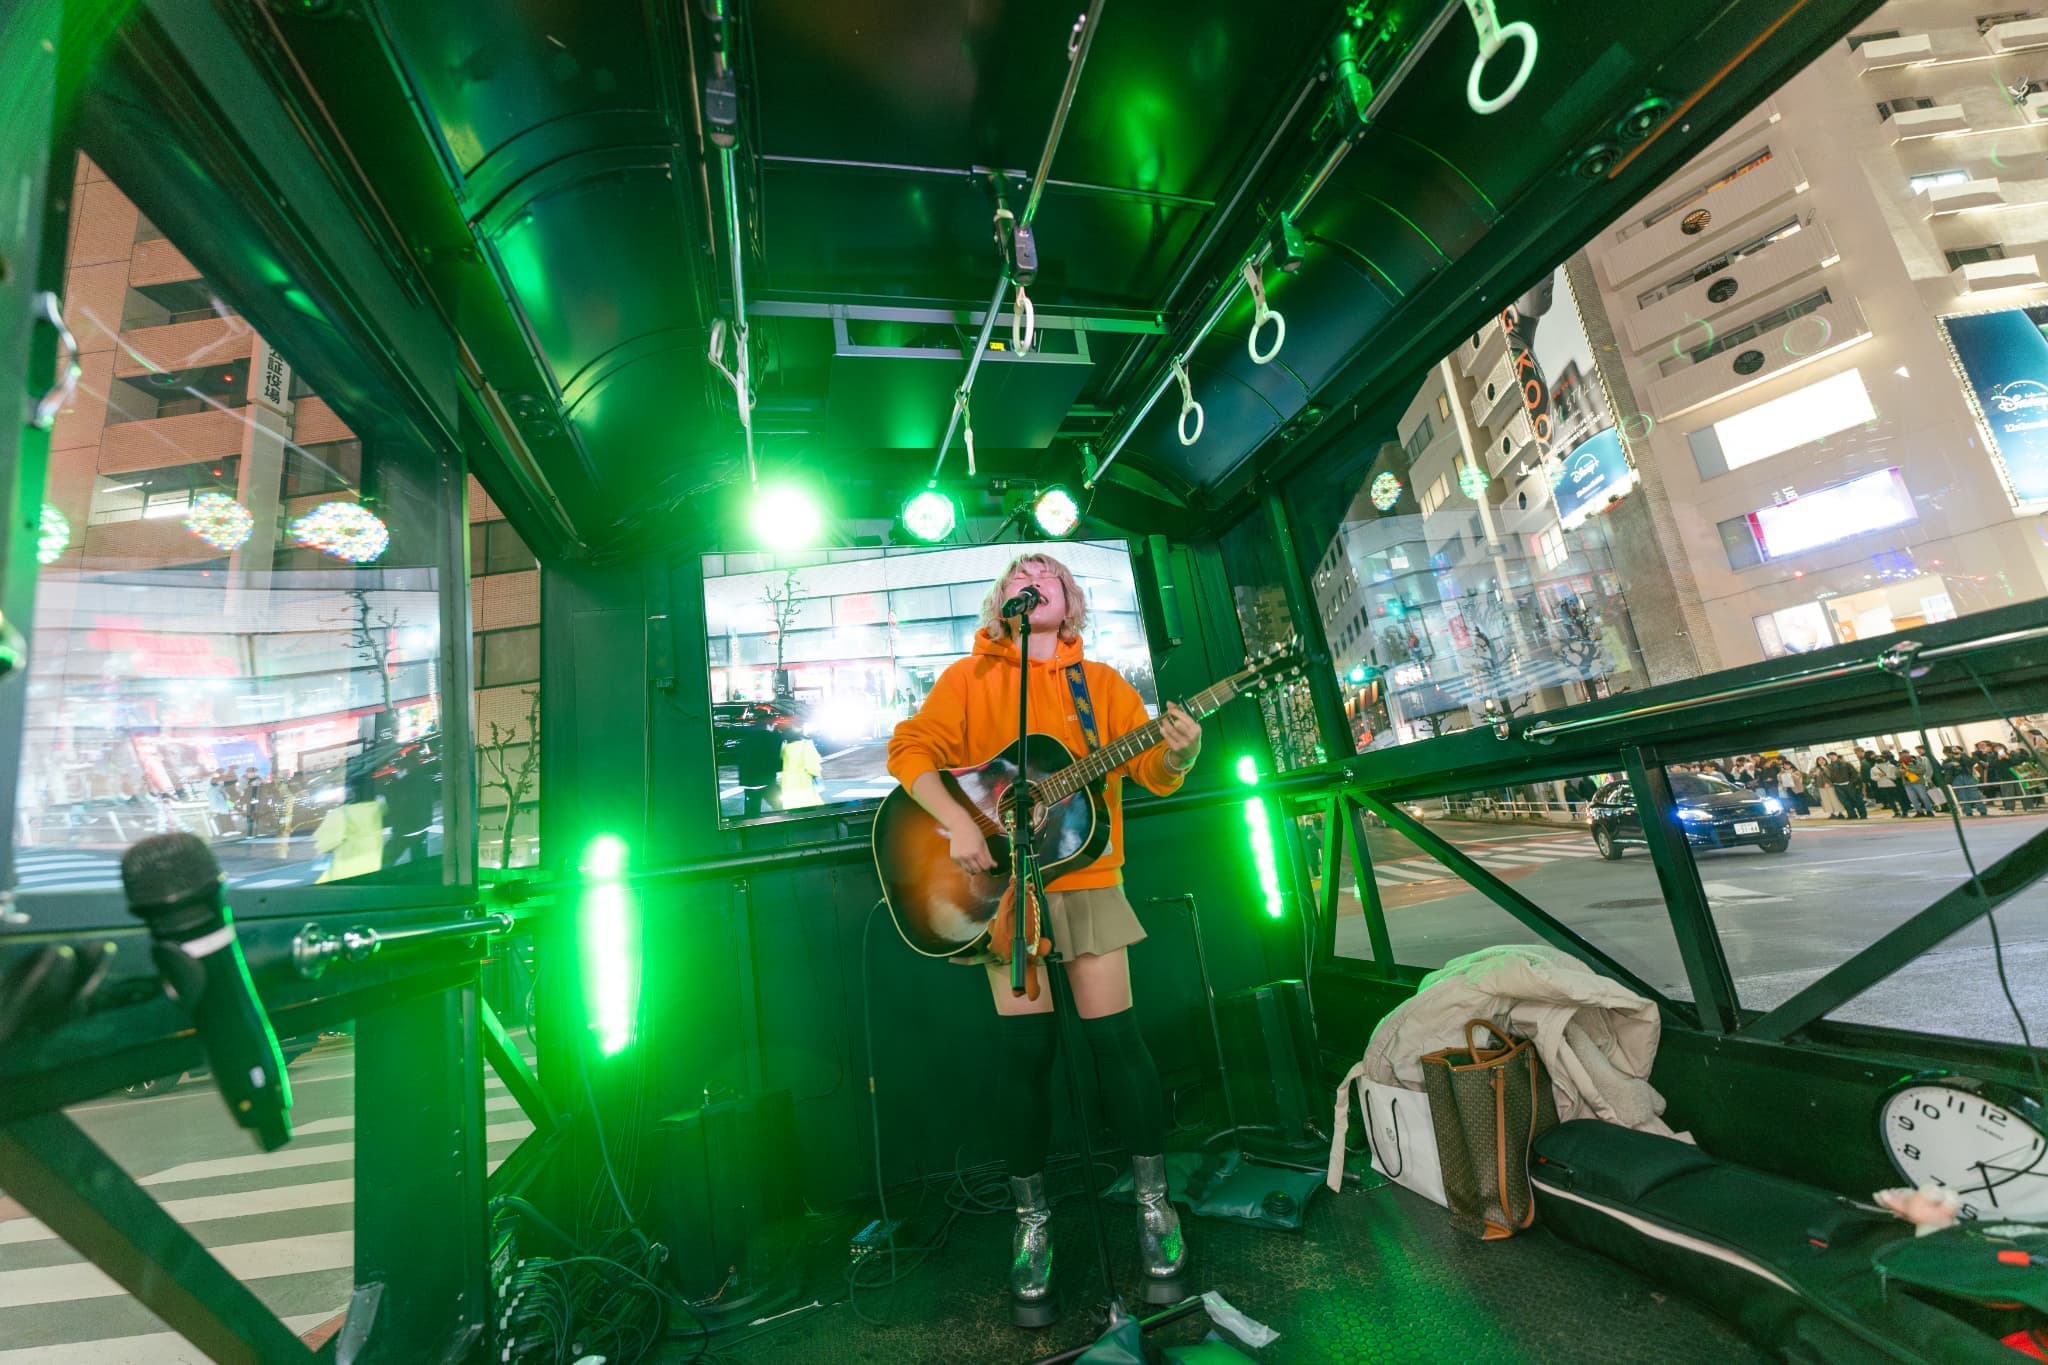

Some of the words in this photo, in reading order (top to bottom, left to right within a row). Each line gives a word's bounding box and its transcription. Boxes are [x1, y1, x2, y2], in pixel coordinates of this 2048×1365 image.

[1914, 1099, 1940, 1120] 10
[1947, 1096, 1965, 1114] 11
[1898, 1116, 1914, 1131] 9
[1980, 1104, 2008, 1128] 12
[1903, 1144, 1921, 1161] 8
